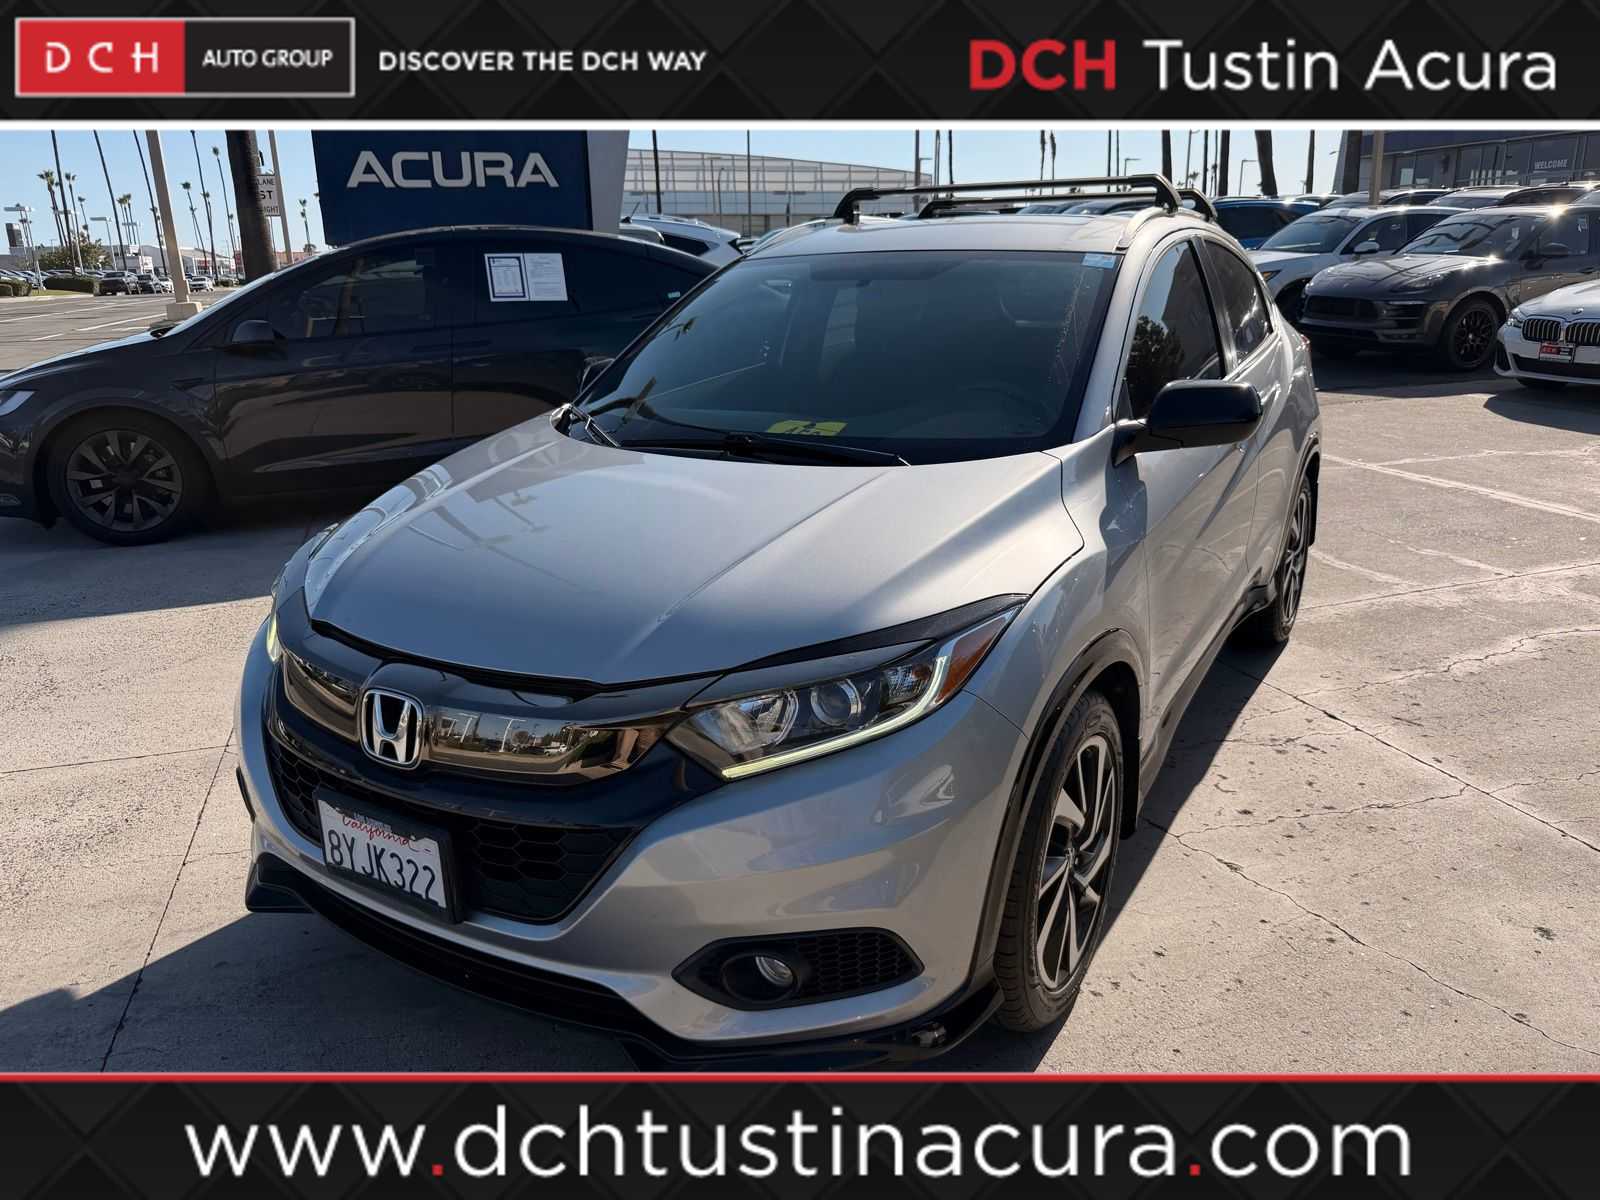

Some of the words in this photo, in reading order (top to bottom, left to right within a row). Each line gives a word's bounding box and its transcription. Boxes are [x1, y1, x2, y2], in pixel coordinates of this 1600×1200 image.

[347, 151, 558, 188] ACURA
[1534, 160, 1568, 170] WELCOME
[327, 828, 436, 902] 8YJK322
